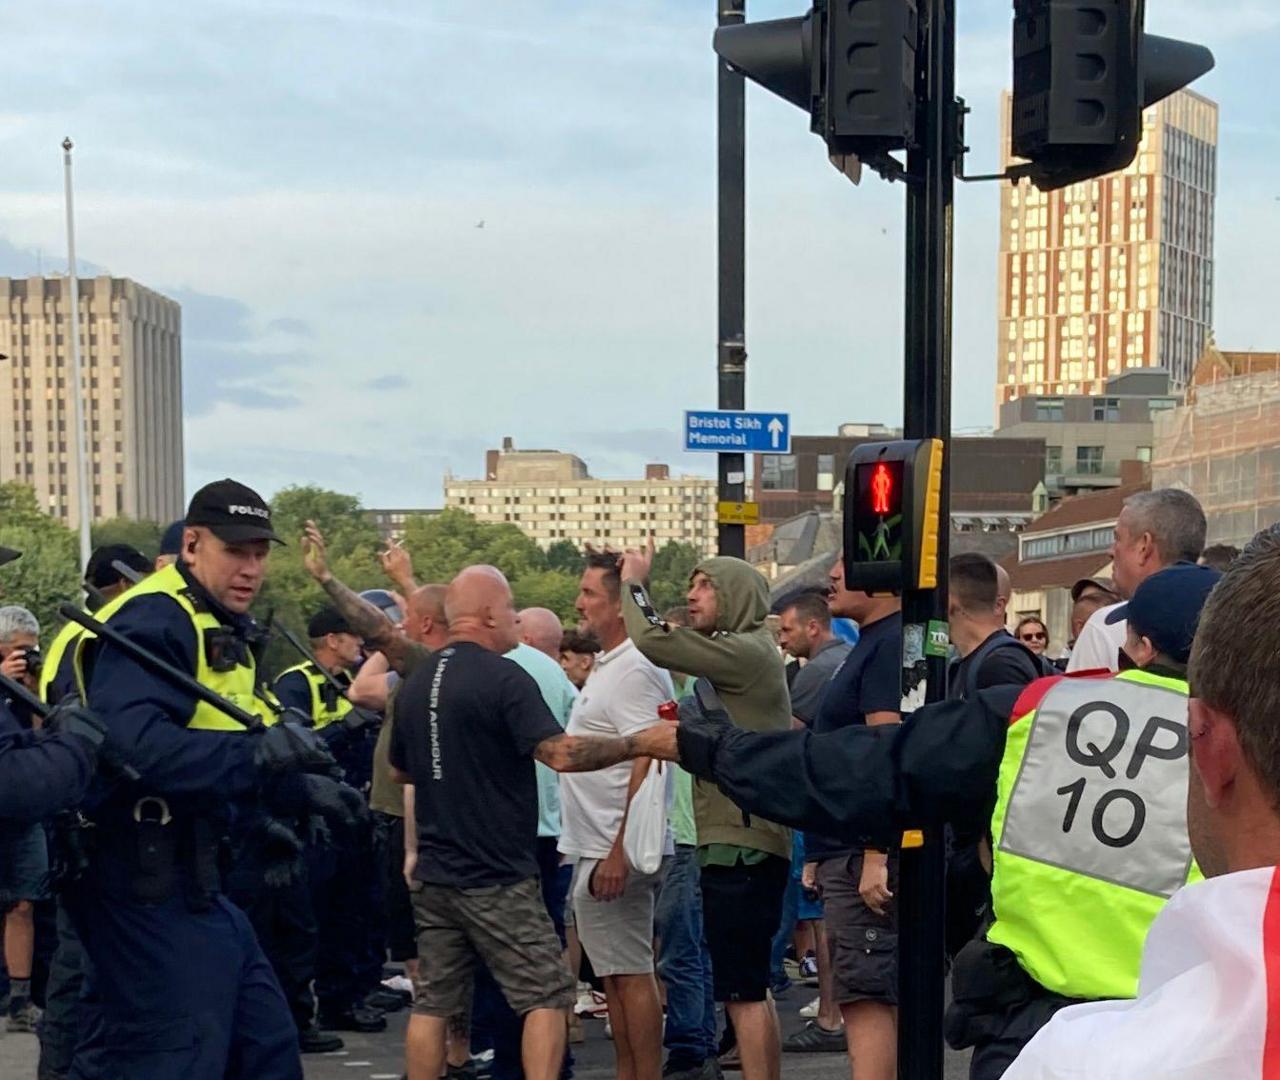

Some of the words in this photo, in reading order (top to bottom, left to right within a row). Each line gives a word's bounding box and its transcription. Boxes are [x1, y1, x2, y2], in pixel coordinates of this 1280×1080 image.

[688, 416, 732, 430] Bristol
[734, 417, 762, 430] Sikh
[688, 432, 748, 446] Memorial
[429, 657, 449, 709] UNDER
[429, 710, 443, 781] ARMOUR
[1065, 700, 1188, 780] QP
[1056, 776, 1146, 849] 10
